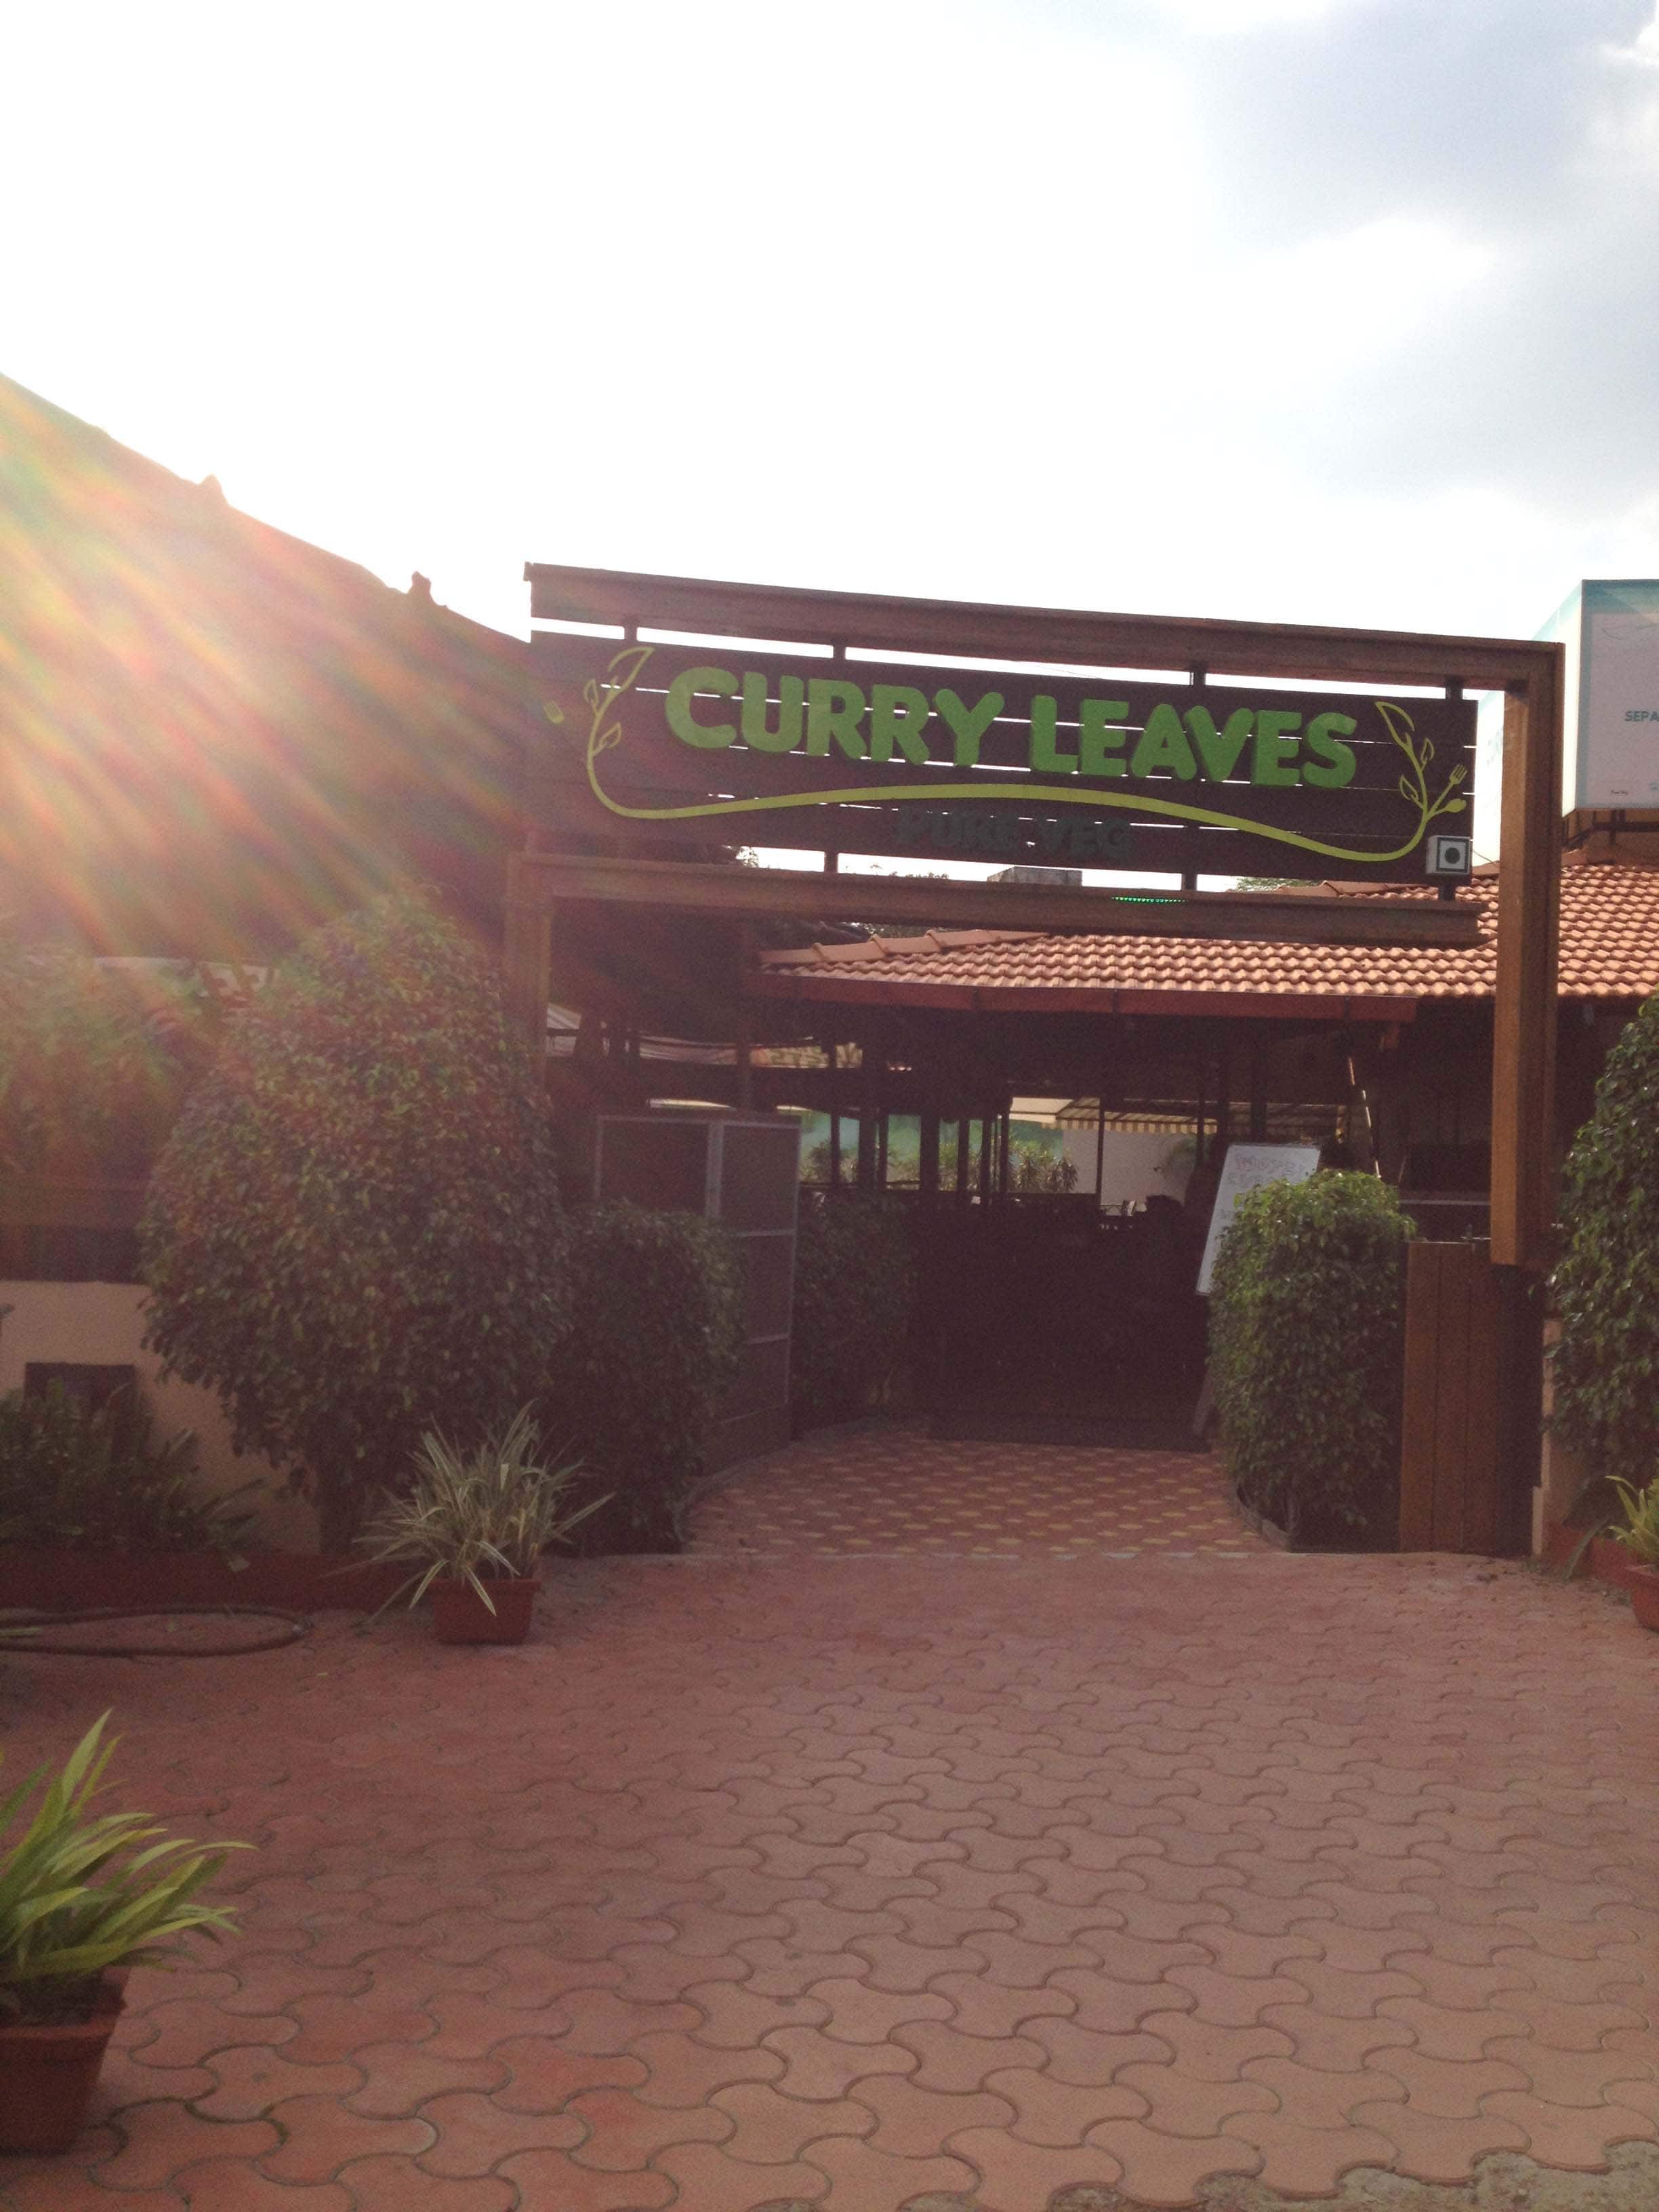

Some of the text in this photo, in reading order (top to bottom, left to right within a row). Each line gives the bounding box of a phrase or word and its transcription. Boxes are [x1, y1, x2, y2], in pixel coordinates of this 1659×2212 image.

[665, 667, 1357, 788] CURRY LEAVES
[1036, 813, 1131, 860] VEG
